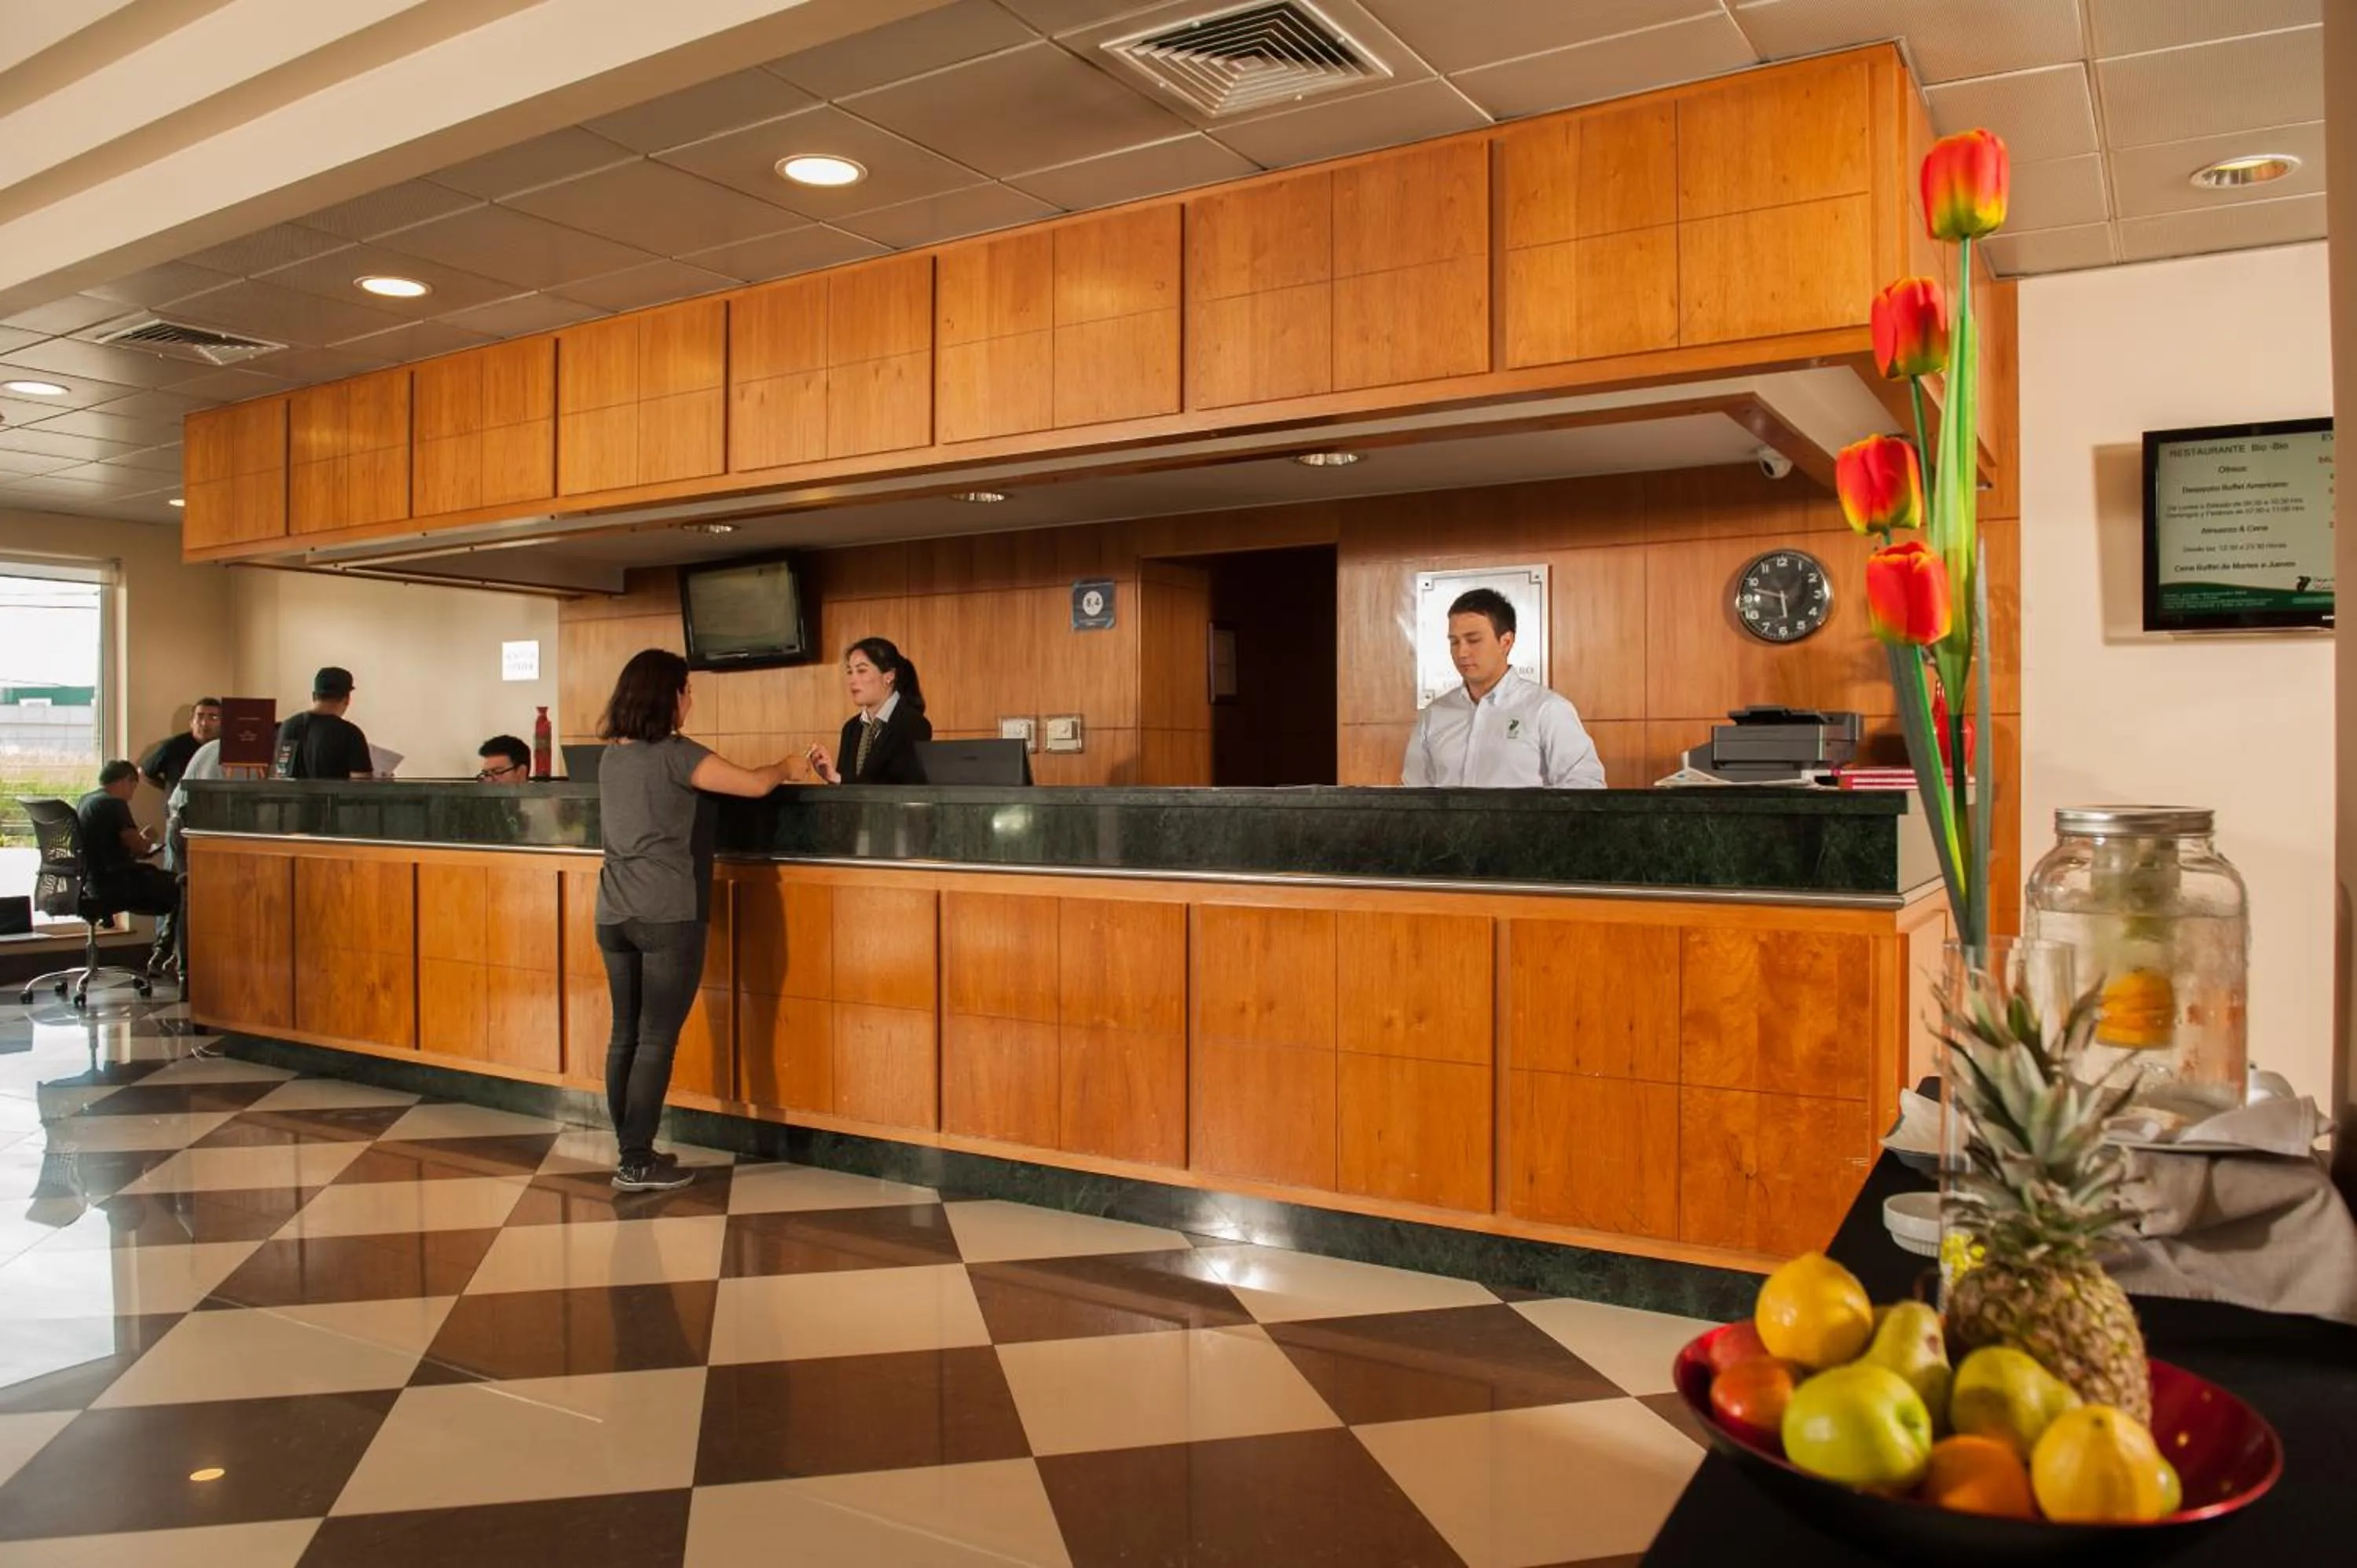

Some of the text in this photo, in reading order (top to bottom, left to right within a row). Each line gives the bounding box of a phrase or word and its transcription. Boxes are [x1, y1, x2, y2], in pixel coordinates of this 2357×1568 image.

[2169, 444, 2246, 458] RESTAURANTE
[1808, 573, 1817, 583] 2
[1813, 590, 1822, 599] 3
[1808, 606, 1817, 616] 4
[1778, 626, 1788, 636] 6
